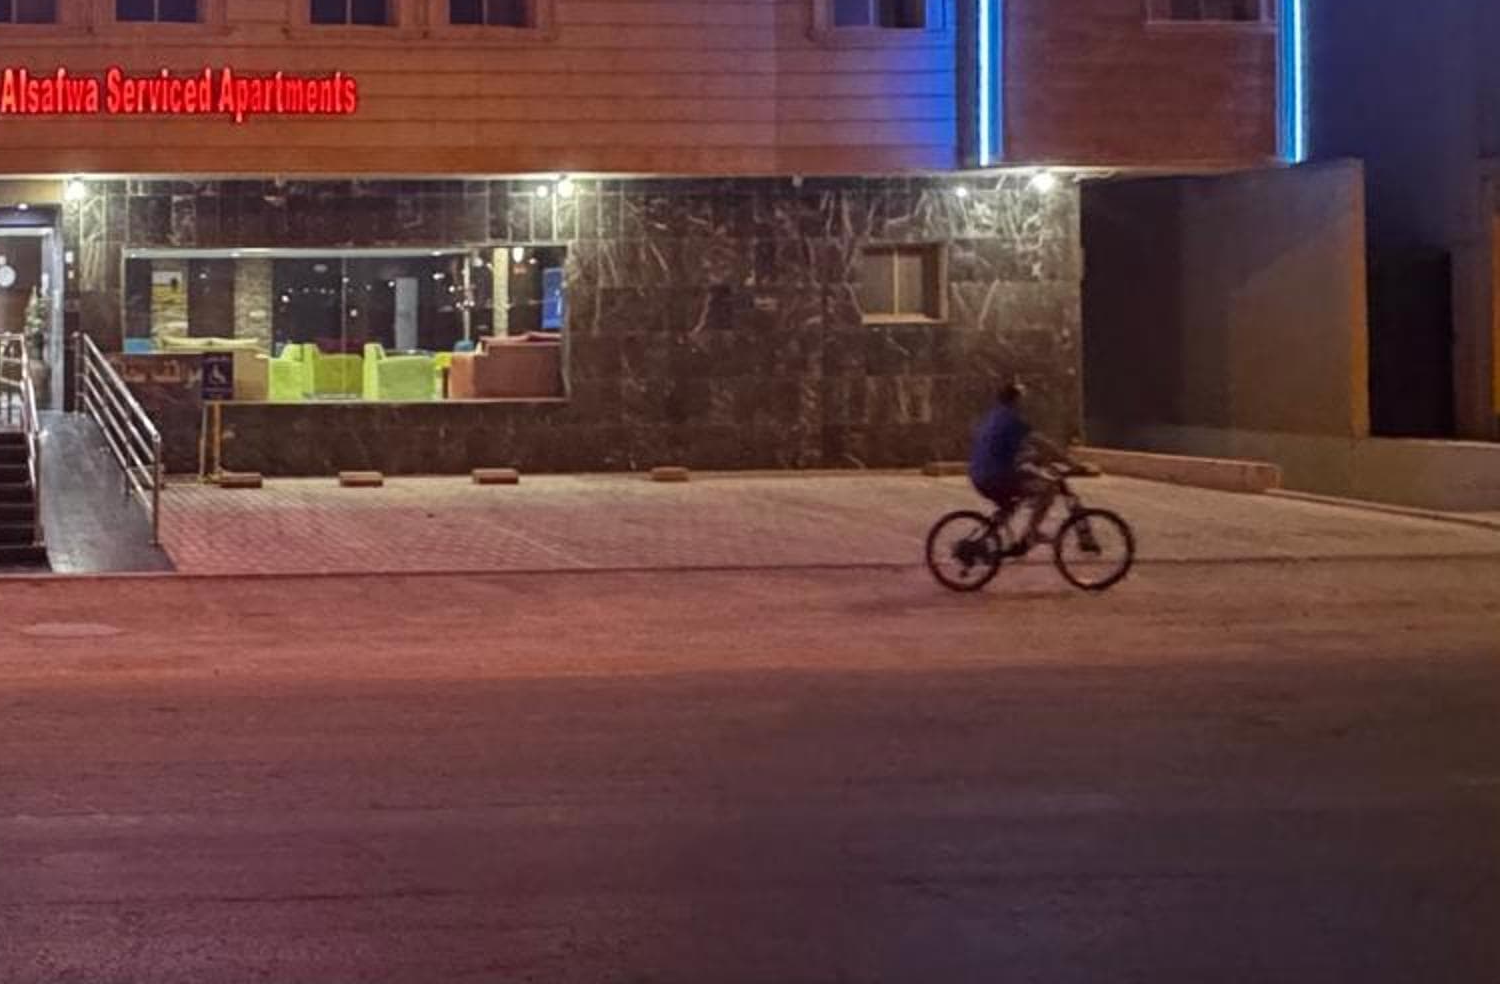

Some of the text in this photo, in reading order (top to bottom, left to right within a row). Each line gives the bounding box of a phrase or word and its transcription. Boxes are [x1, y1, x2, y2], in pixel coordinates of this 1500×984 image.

[0, 68, 100, 114] Alsafwa
[106, 67, 213, 114] Serviced
[216, 67, 358, 123] Apartments
